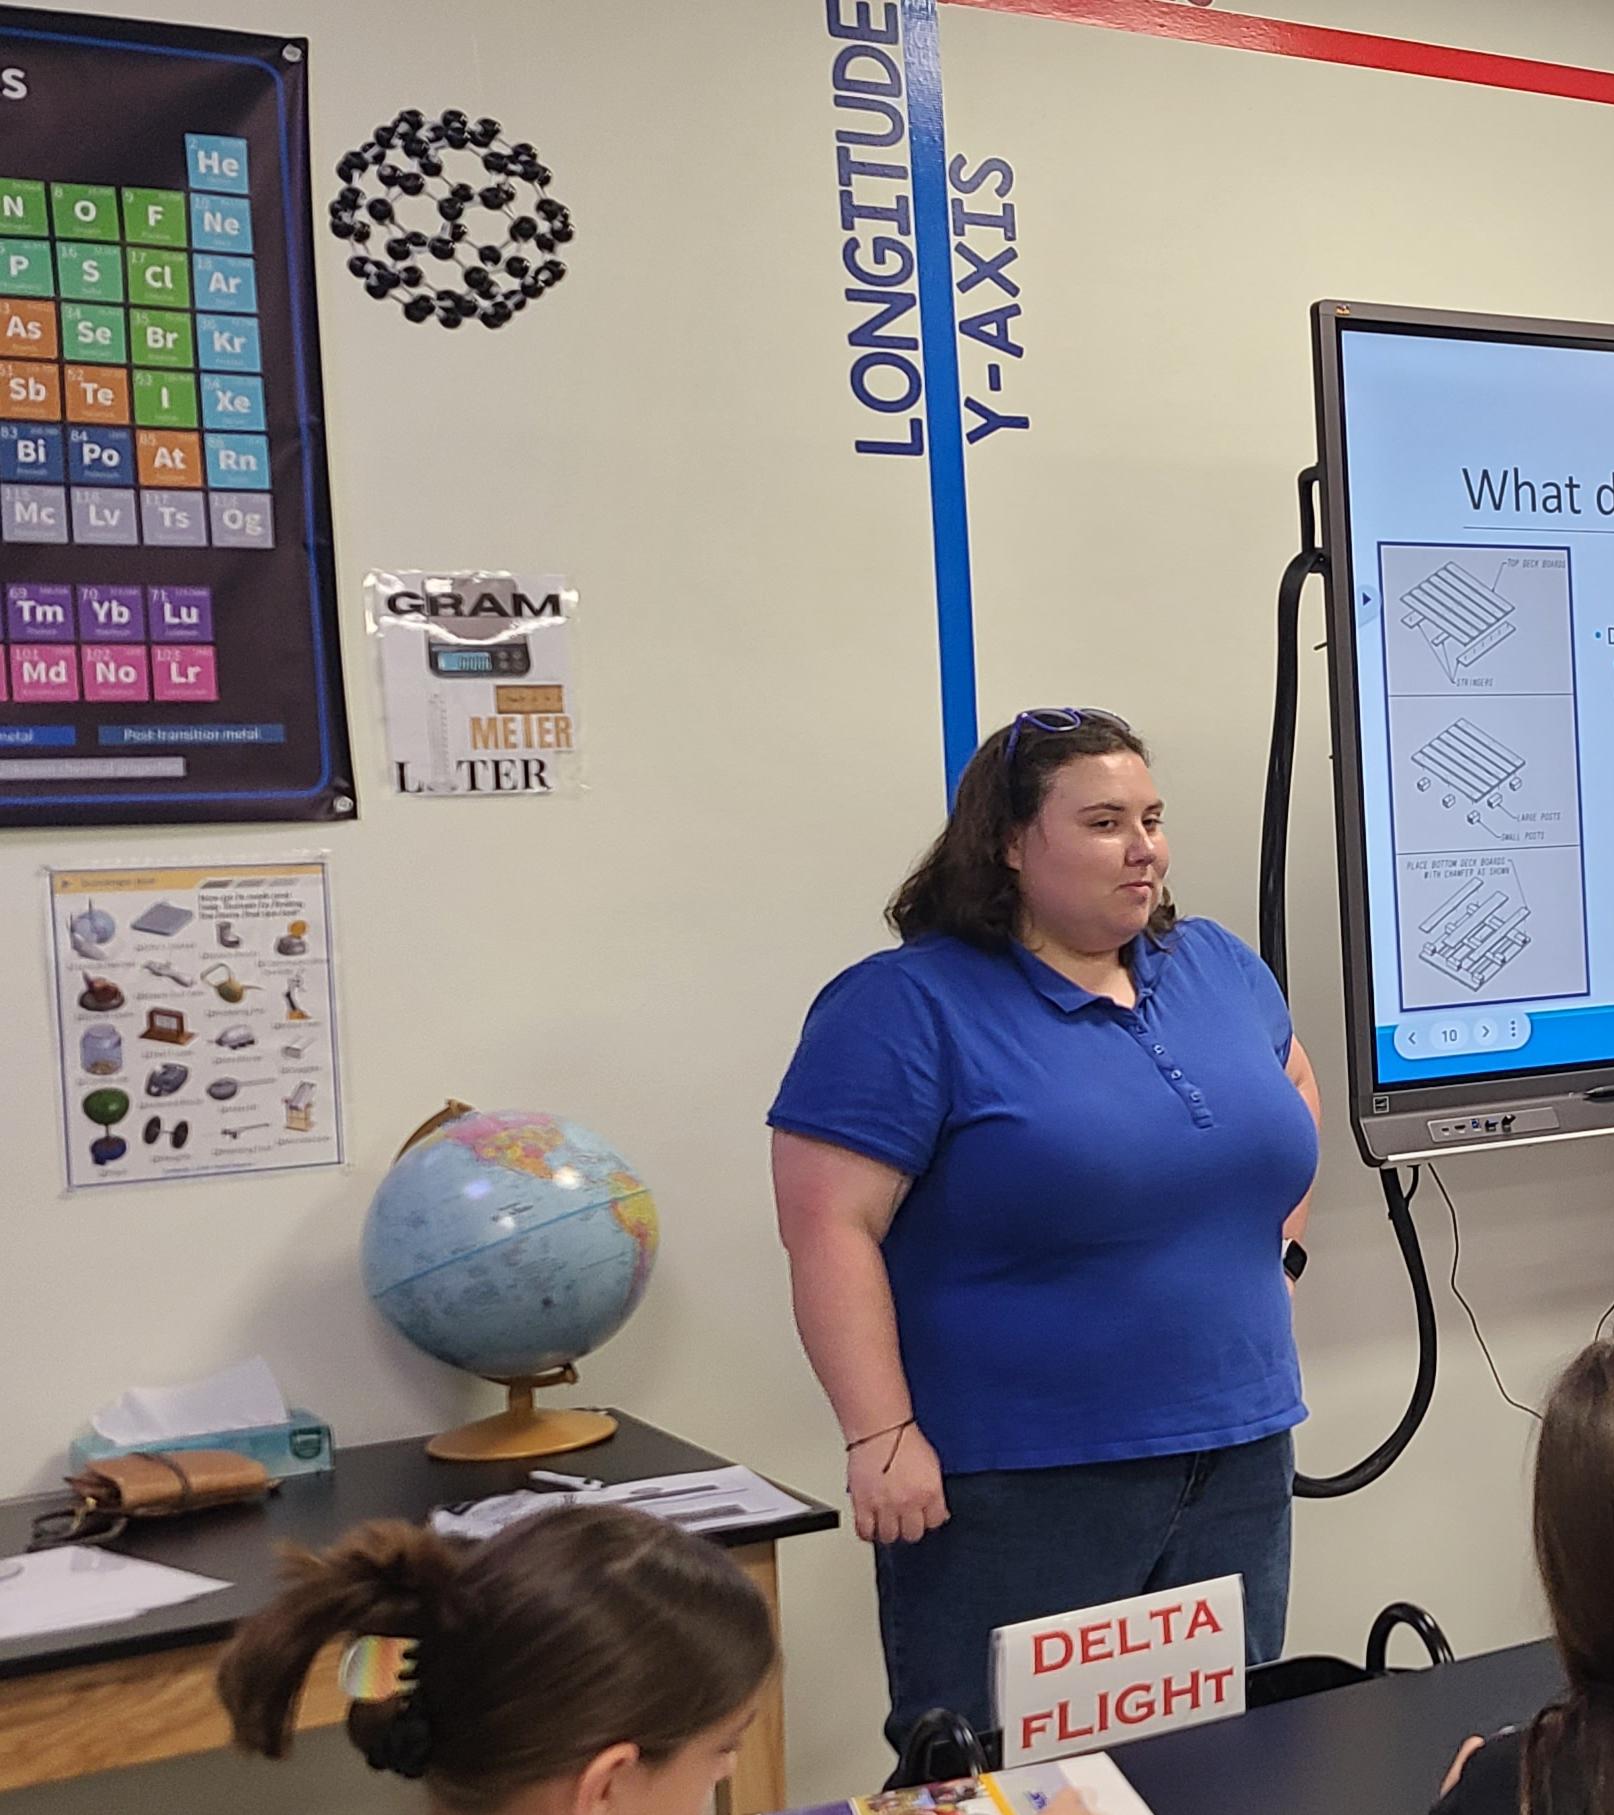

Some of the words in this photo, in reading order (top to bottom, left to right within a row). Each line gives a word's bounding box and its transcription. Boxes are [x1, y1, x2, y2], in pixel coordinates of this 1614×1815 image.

[198, 152, 239, 176] He
[3, 195, 24, 218] N
[74, 200, 97, 222] O
[148, 205, 164, 227] F
[203, 211, 240, 236] Ne
[825, 0, 925, 457] LONGITUDE
[10, 255, 29, 277] P
[82, 260, 100, 282] S
[145, 266, 173, 289] Cl
[209, 272, 242, 293] Ar
[948, 153, 1030, 446] Y-AXIS
[6, 316, 42, 340] As
[77, 321, 112, 345] Se
[146, 326, 179, 349] Br
[213, 331, 247, 353] Kr
[9, 376, 46, 402] Sb
[81, 382, 115, 406] Te
[161, 387, 170, 409] I
[216, 390, 251, 413] Xe
[17, 439, 46, 463] Bi
[82, 442, 120, 467] Po
[153, 447, 186, 470] At
[218, 450, 257, 472] Rn
[1462, 467, 1582, 516] What
[14, 502, 55, 525] Mc
[89, 504, 120, 527] Lv
[157, 506, 190, 528] Ts
[222, 508, 262, 536] Og
[1507, 558, 1520, 568] TOP
[16, 600, 64, 624] Tm
[91, 600, 130, 624] Yb
[164, 602, 199, 625] Lu
[387, 591, 561, 618] GRAM
[22, 660, 67, 684] Md
[95, 661, 138, 684] No
[171, 662, 201, 684] Lr
[469, 715, 573, 751] METER
[1441, 1029, 1458, 1043] 10
[1032, 1598, 1223, 1675] DELTA
[1021, 1667, 1234, 1749] FLIGHT
